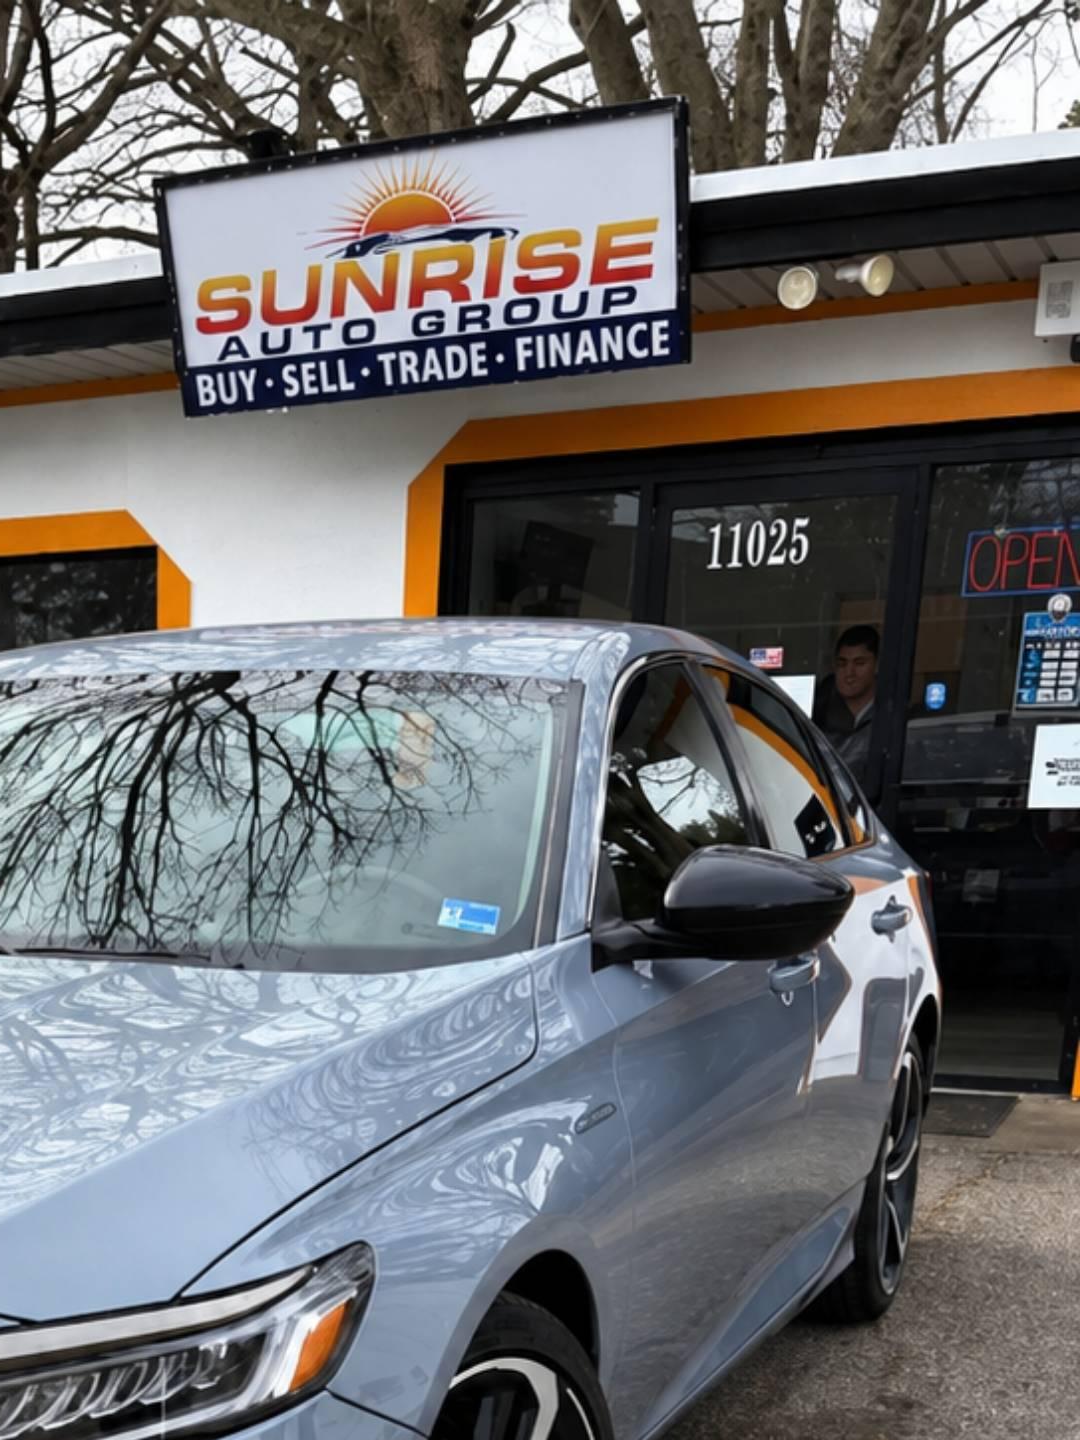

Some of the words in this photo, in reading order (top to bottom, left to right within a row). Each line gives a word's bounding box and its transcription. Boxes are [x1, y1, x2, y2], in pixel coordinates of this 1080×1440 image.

[196, 218, 659, 335] SUNRISE
[195, 367, 257, 407] BUY
[281, 358, 356, 398] SELL
[377, 341, 488, 387] TRADE
[515, 319, 670, 372] FINANCE
[217, 317, 376, 361] AUTO
[411, 285, 637, 337] GROUP
[706, 516, 810, 570] 11025
